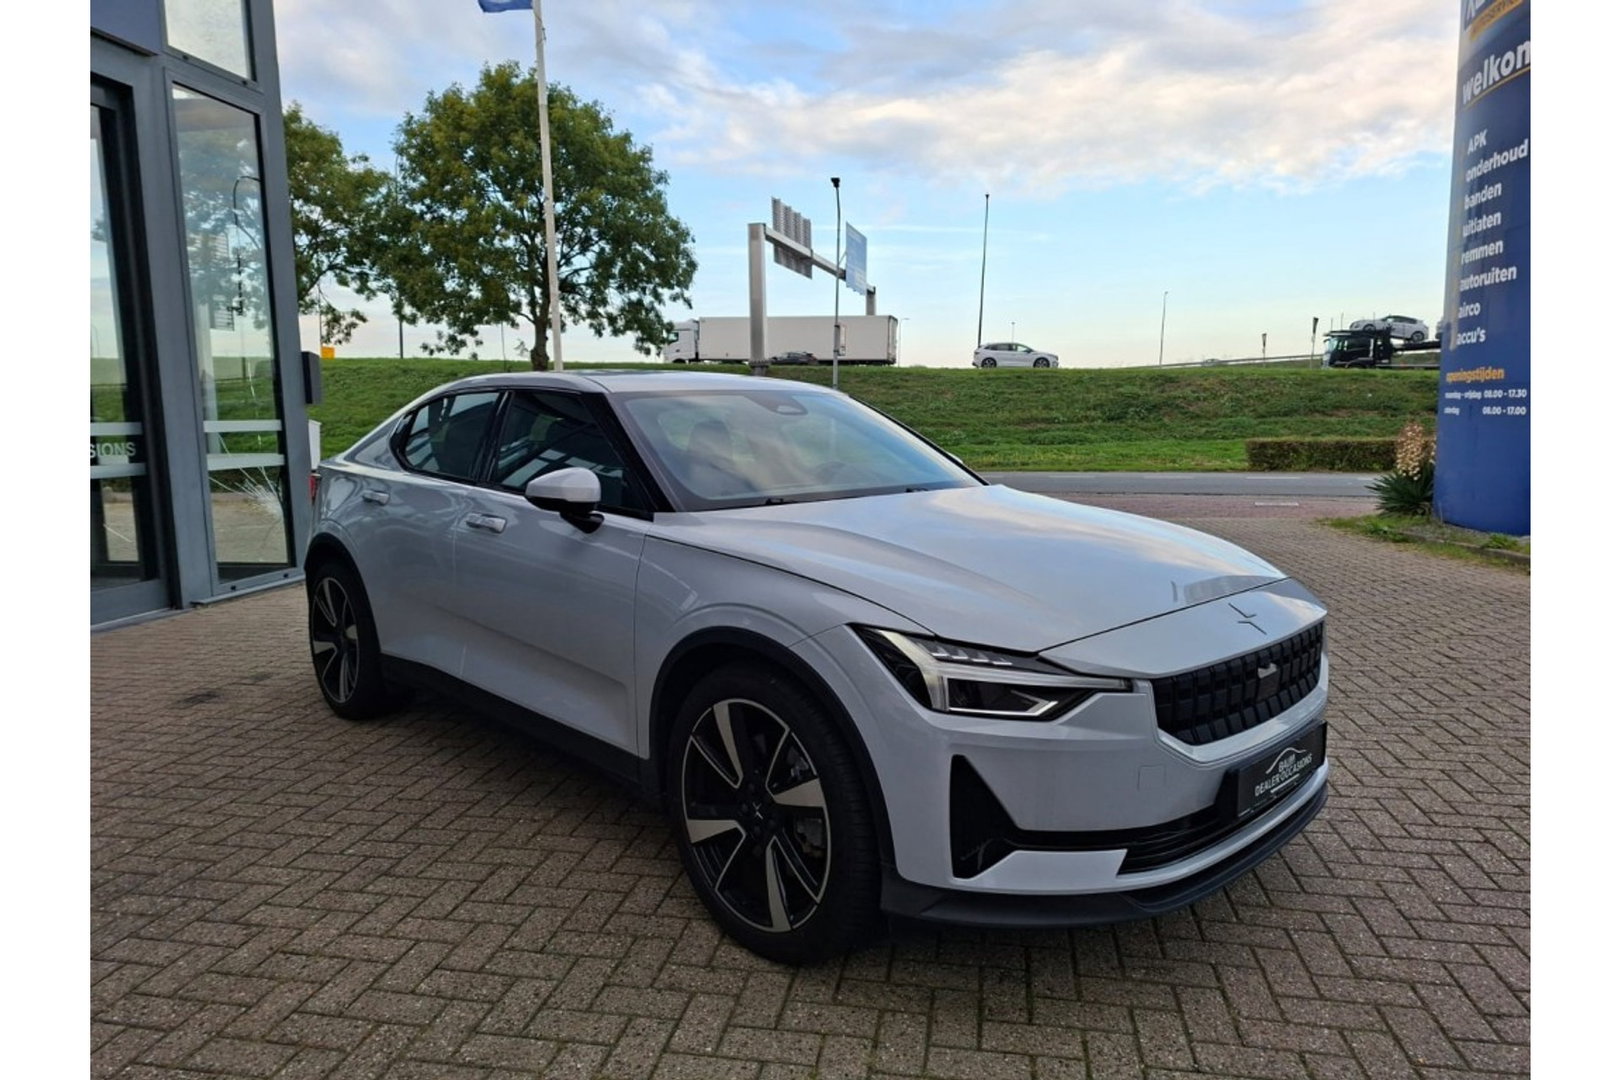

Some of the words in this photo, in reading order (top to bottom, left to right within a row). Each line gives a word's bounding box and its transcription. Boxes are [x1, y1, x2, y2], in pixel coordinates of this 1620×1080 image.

[1467, 129, 1488, 155] APK
[1465, 138, 1529, 182] onderhoud
[1464, 182, 1503, 210] banden
[1462, 211, 1501, 237] uitlaten
[1461, 240, 1504, 266] remmen
[1459, 264, 1518, 292] autoruiten
[1458, 302, 1481, 319] airco
[1456, 327, 1486, 346] accu's
[1508, 389, 1527, 398] 17.30
[1507, 406, 1527, 415] 17.00
